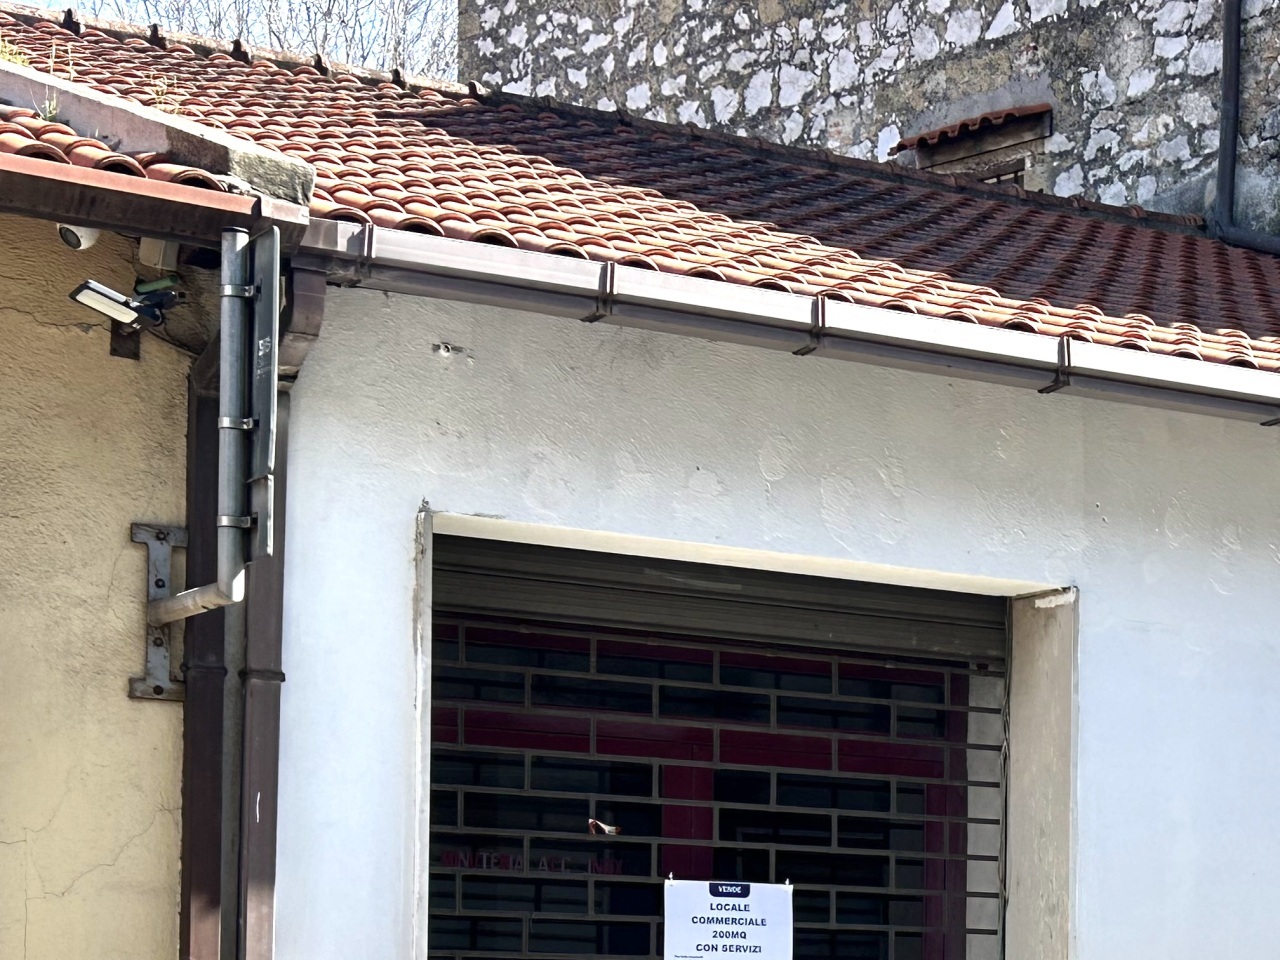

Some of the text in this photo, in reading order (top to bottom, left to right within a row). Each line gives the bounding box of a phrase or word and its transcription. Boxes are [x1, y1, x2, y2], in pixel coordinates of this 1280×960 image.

[718, 885, 742, 894] VENDE
[710, 902, 750, 912] LOCALE
[691, 916, 767, 926] COMMERCIALE
[712, 930, 747, 940] 200MQ
[696, 943, 762, 953] CON SERVIZI
